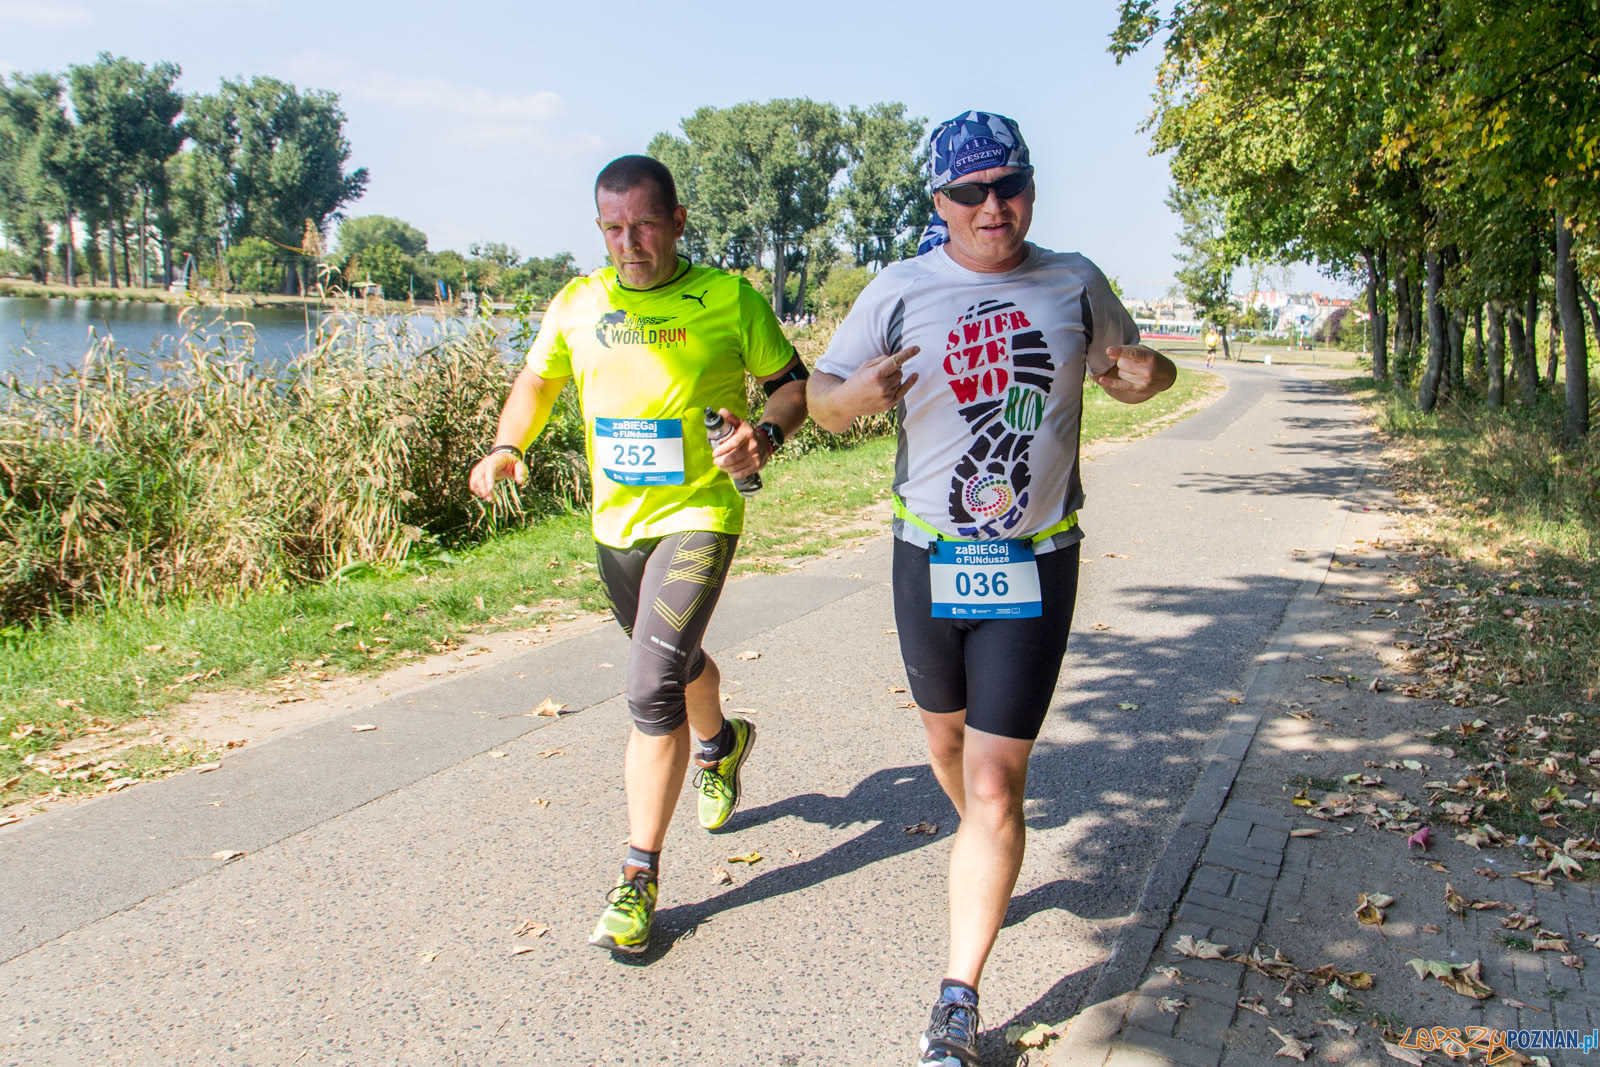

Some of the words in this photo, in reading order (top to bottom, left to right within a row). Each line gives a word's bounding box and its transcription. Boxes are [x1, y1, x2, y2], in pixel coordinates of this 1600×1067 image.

[658, 341, 687, 350] 2017
[943, 337, 1009, 375] CZE
[948, 368, 1009, 404] WO
[1004, 386, 1048, 431] RUN
[612, 420, 658, 432] zaBIEGaj
[613, 444, 657, 466] 252
[955, 543, 1010, 556] zaBIEGaj
[964, 555, 1010, 565] FUNdusze
[955, 571, 1009, 597] 036
